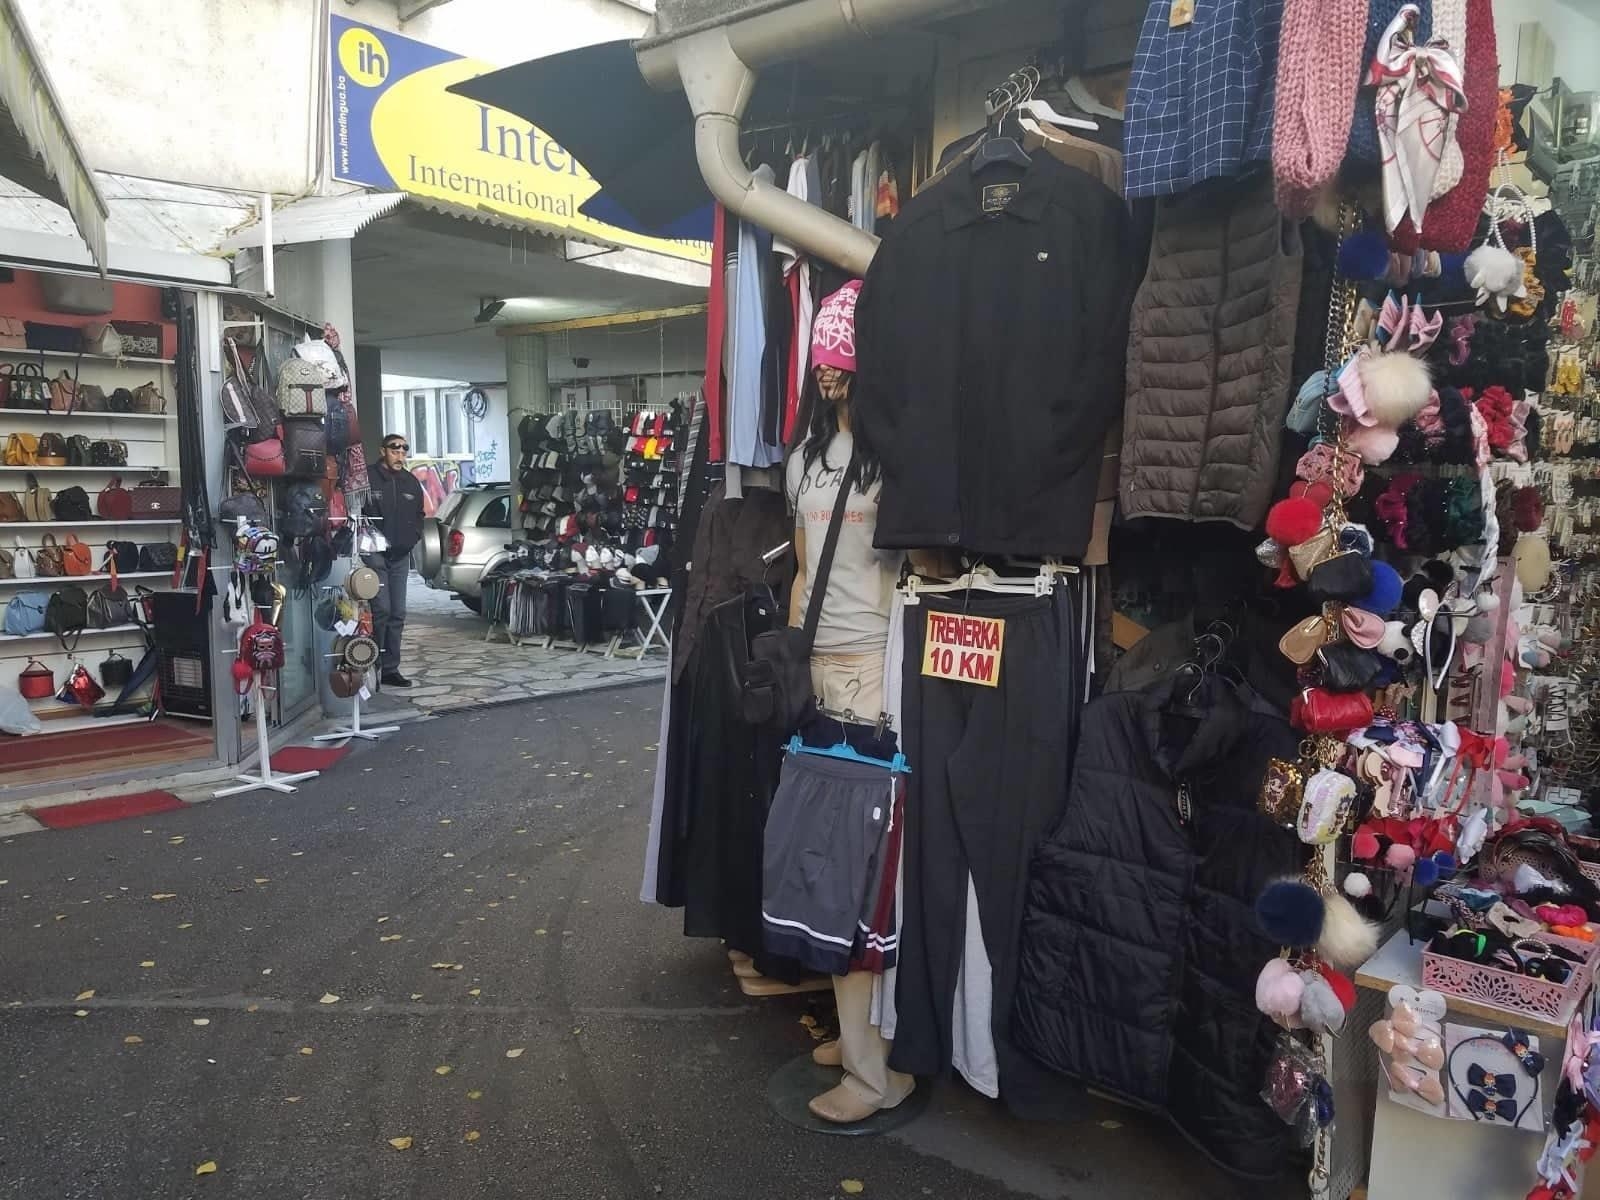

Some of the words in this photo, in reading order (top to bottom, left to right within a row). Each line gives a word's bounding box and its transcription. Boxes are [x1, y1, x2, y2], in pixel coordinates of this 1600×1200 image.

[358, 41, 385, 78] ih
[336, 75, 349, 174] www.interlingua.ba
[408, 154, 575, 218] International
[929, 614, 1000, 651] TRENERKA
[931, 647, 954, 675] 10
[959, 651, 995, 681] KM
